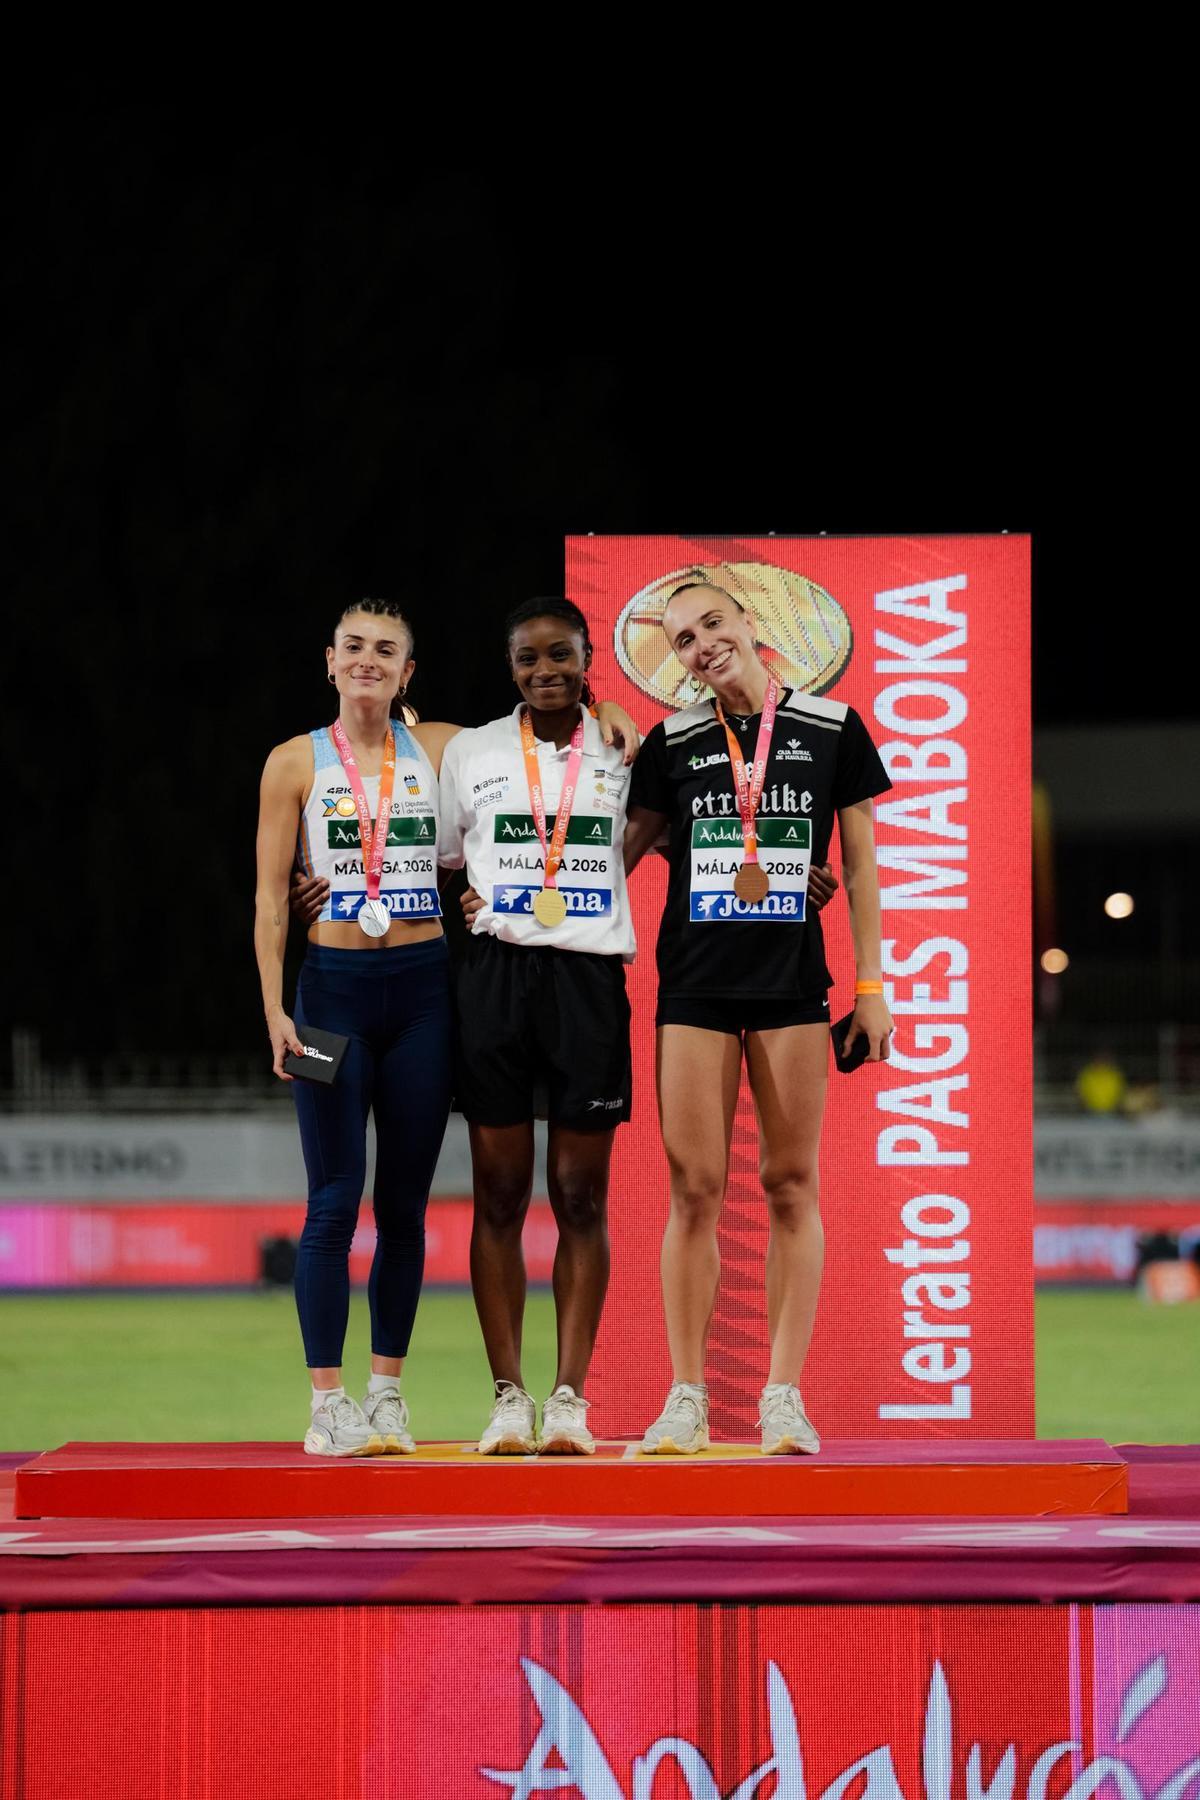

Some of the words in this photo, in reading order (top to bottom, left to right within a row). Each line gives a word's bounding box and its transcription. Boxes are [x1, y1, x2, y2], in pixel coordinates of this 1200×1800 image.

[873, 573, 969, 910] MABOKA
[734, 760, 749, 806] ATLETISMO
[751, 760, 764, 806] ATLETISMO
[357, 794, 372, 842] ATLETISMO
[376, 796, 390, 844] ATLETISMO
[532, 784, 546, 831] ATLETISMO
[557, 785, 574, 831] ATLETISMO
[335, 859, 402, 875] MÁLGA
[404, 859, 433, 872] 2026
[499, 854, 568, 870] MÁLAA
[572, 858, 607, 872] 2026
[697, 859, 743, 875] MÁLA
[766, 862, 804, 875] 2026
[365, 892, 434, 913] oma
[523, 889, 605, 912] Jma
[876, 937, 970, 1165] PAGES
[877, 1193, 972, 1418] Lerato
